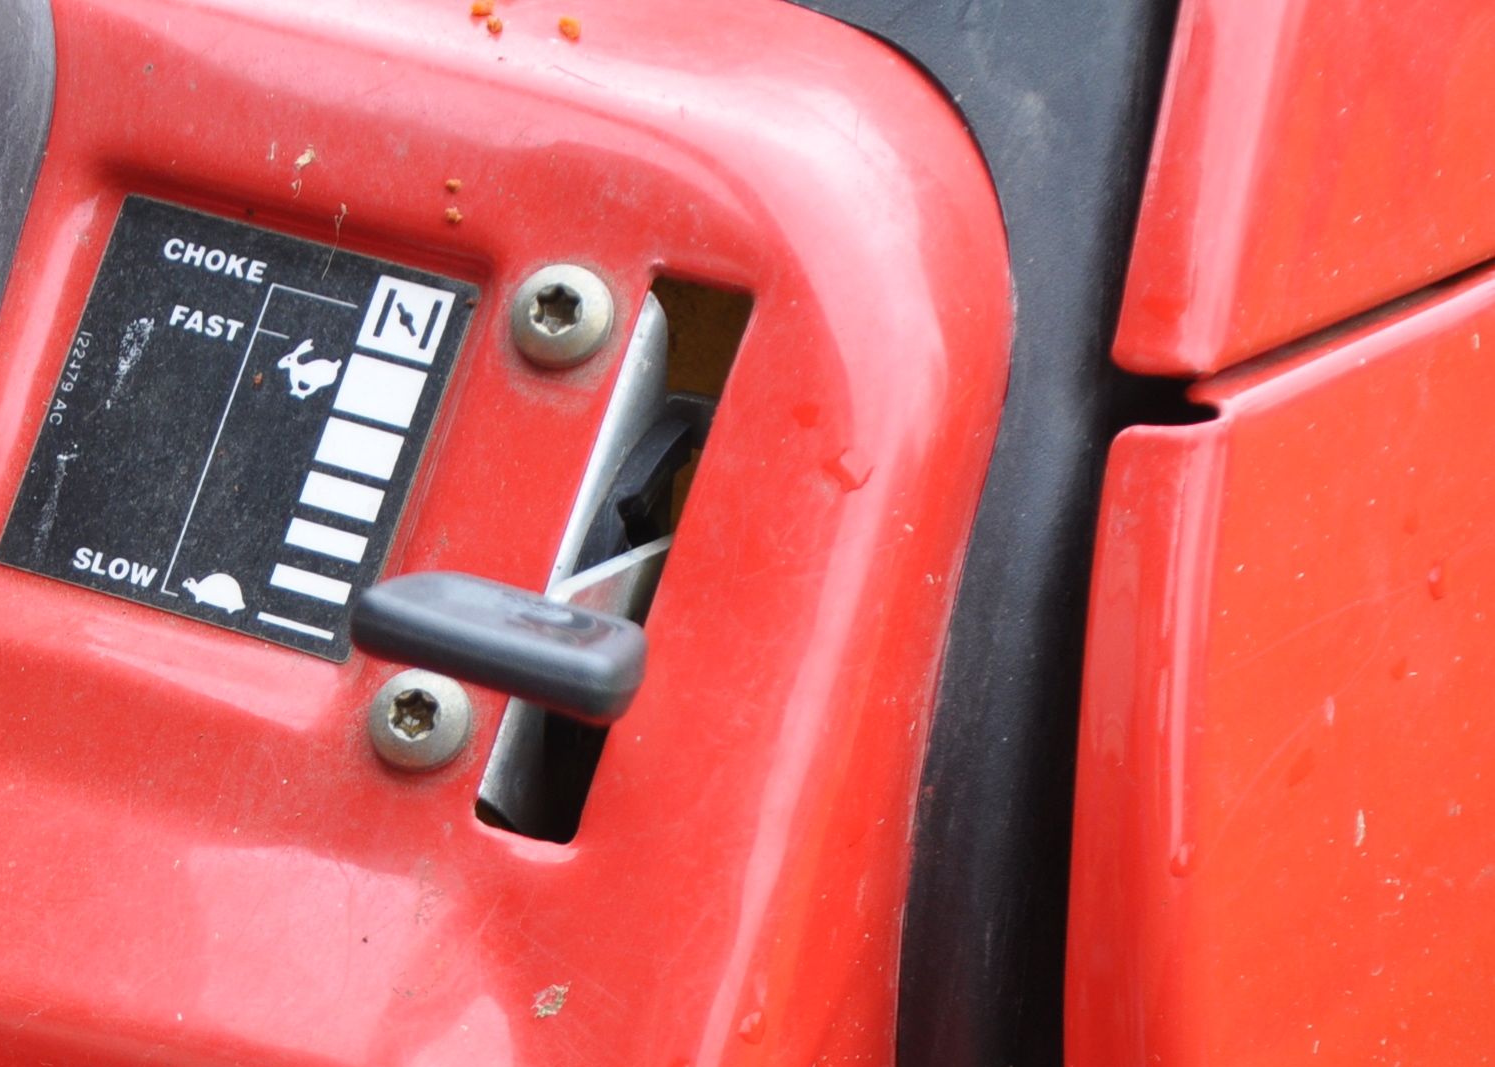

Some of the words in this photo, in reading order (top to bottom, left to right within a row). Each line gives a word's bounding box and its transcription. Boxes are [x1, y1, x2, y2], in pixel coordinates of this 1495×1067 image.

[163, 238, 268, 284] CHOKE
[169, 304, 245, 342] FAST
[49, 398, 67, 425] AC
[73, 547, 158, 588] SLOW
